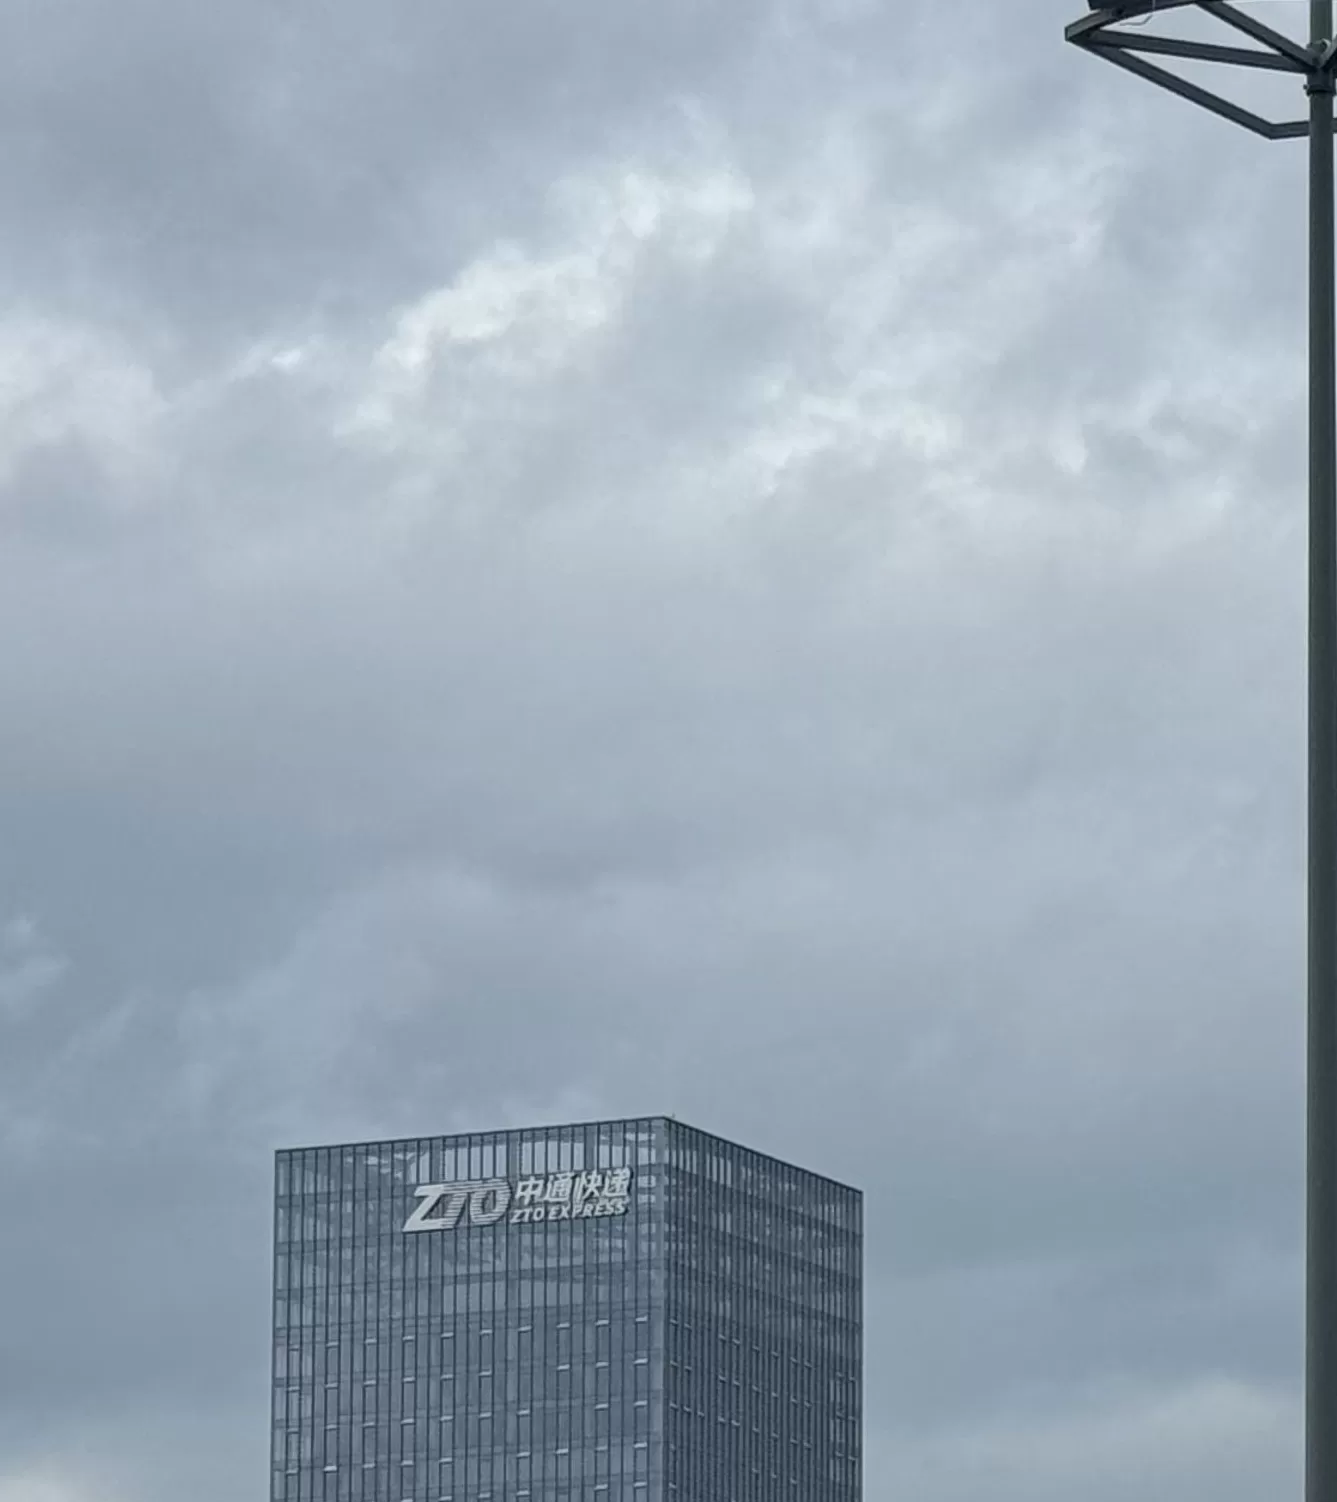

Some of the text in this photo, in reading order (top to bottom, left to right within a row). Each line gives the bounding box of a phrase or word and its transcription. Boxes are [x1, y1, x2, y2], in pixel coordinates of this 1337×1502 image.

[514, 1168, 631, 1204] 中通快递
[402, 1178, 511, 1232] ZTO
[510, 1201, 627, 1224] ZTO EXPRESS
